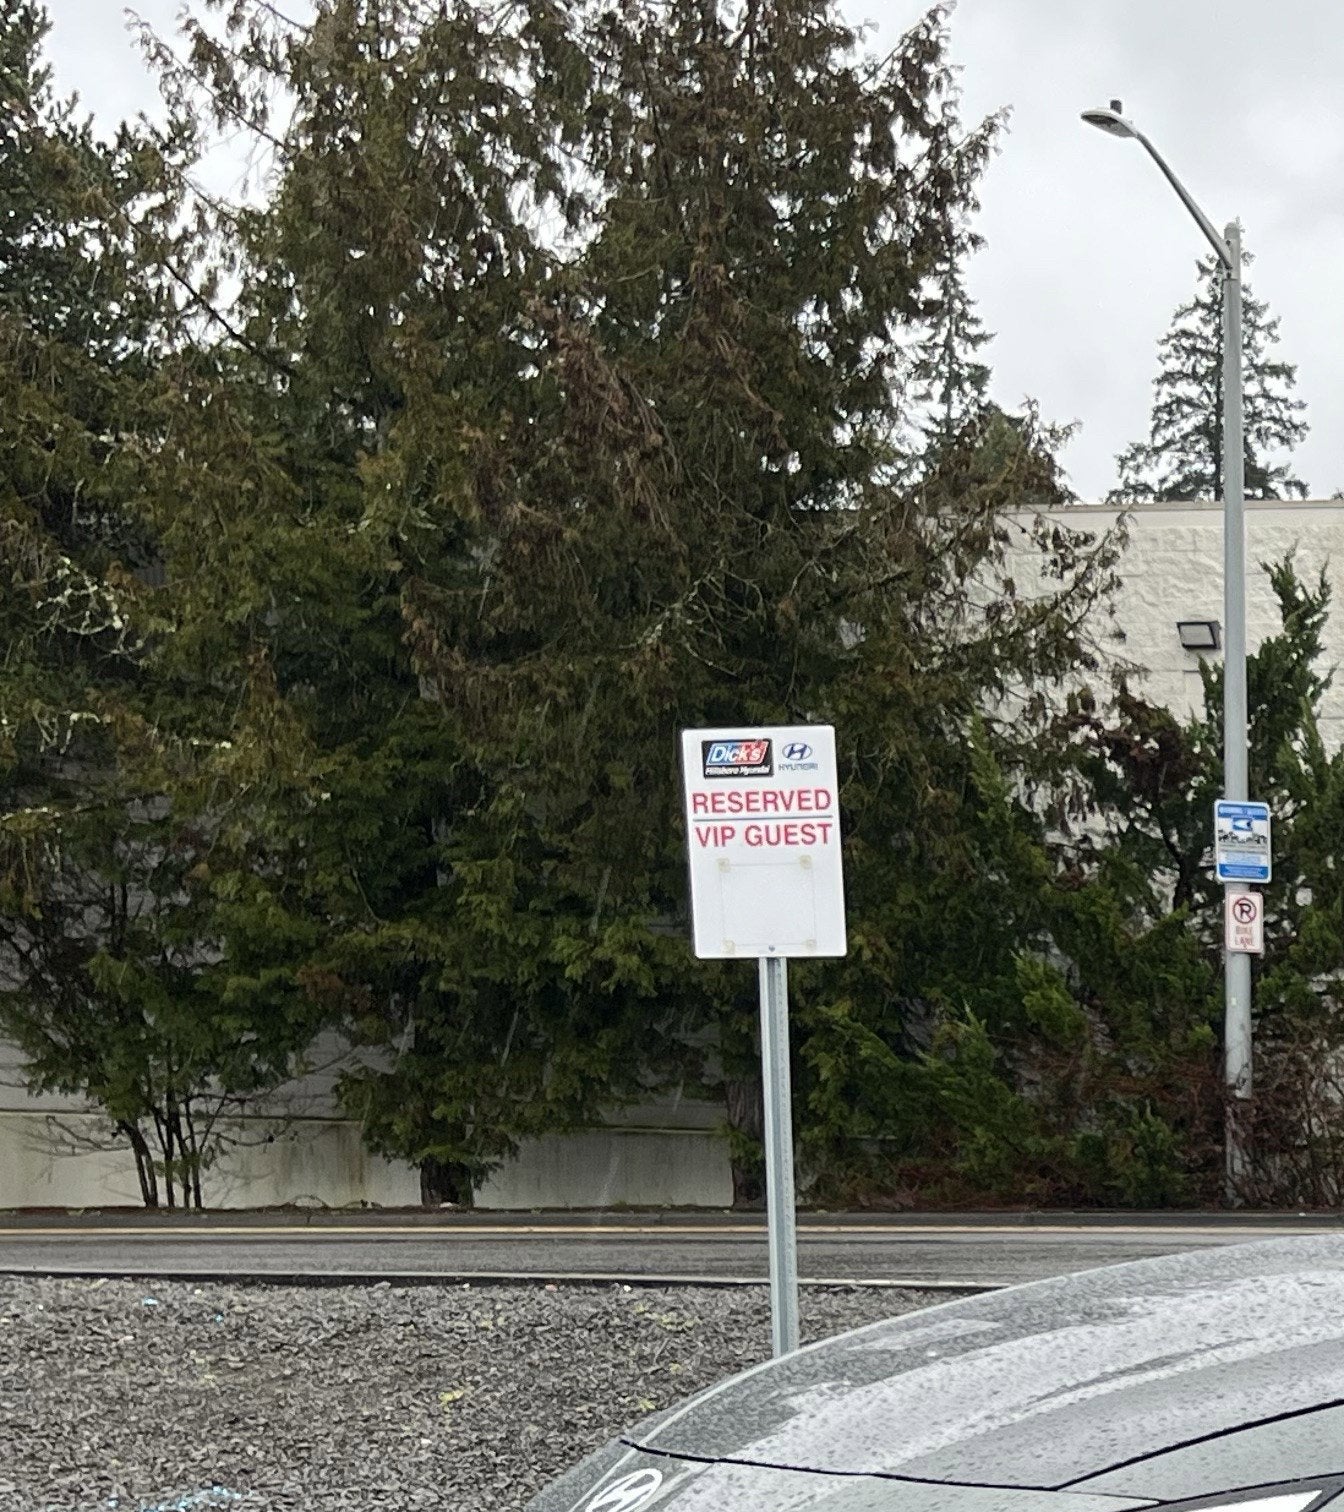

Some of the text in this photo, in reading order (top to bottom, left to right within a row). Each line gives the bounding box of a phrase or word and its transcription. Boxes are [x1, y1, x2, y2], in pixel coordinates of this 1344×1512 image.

[692, 789, 832, 814] RESERVED
[695, 823, 833, 848] VIP GUEST
